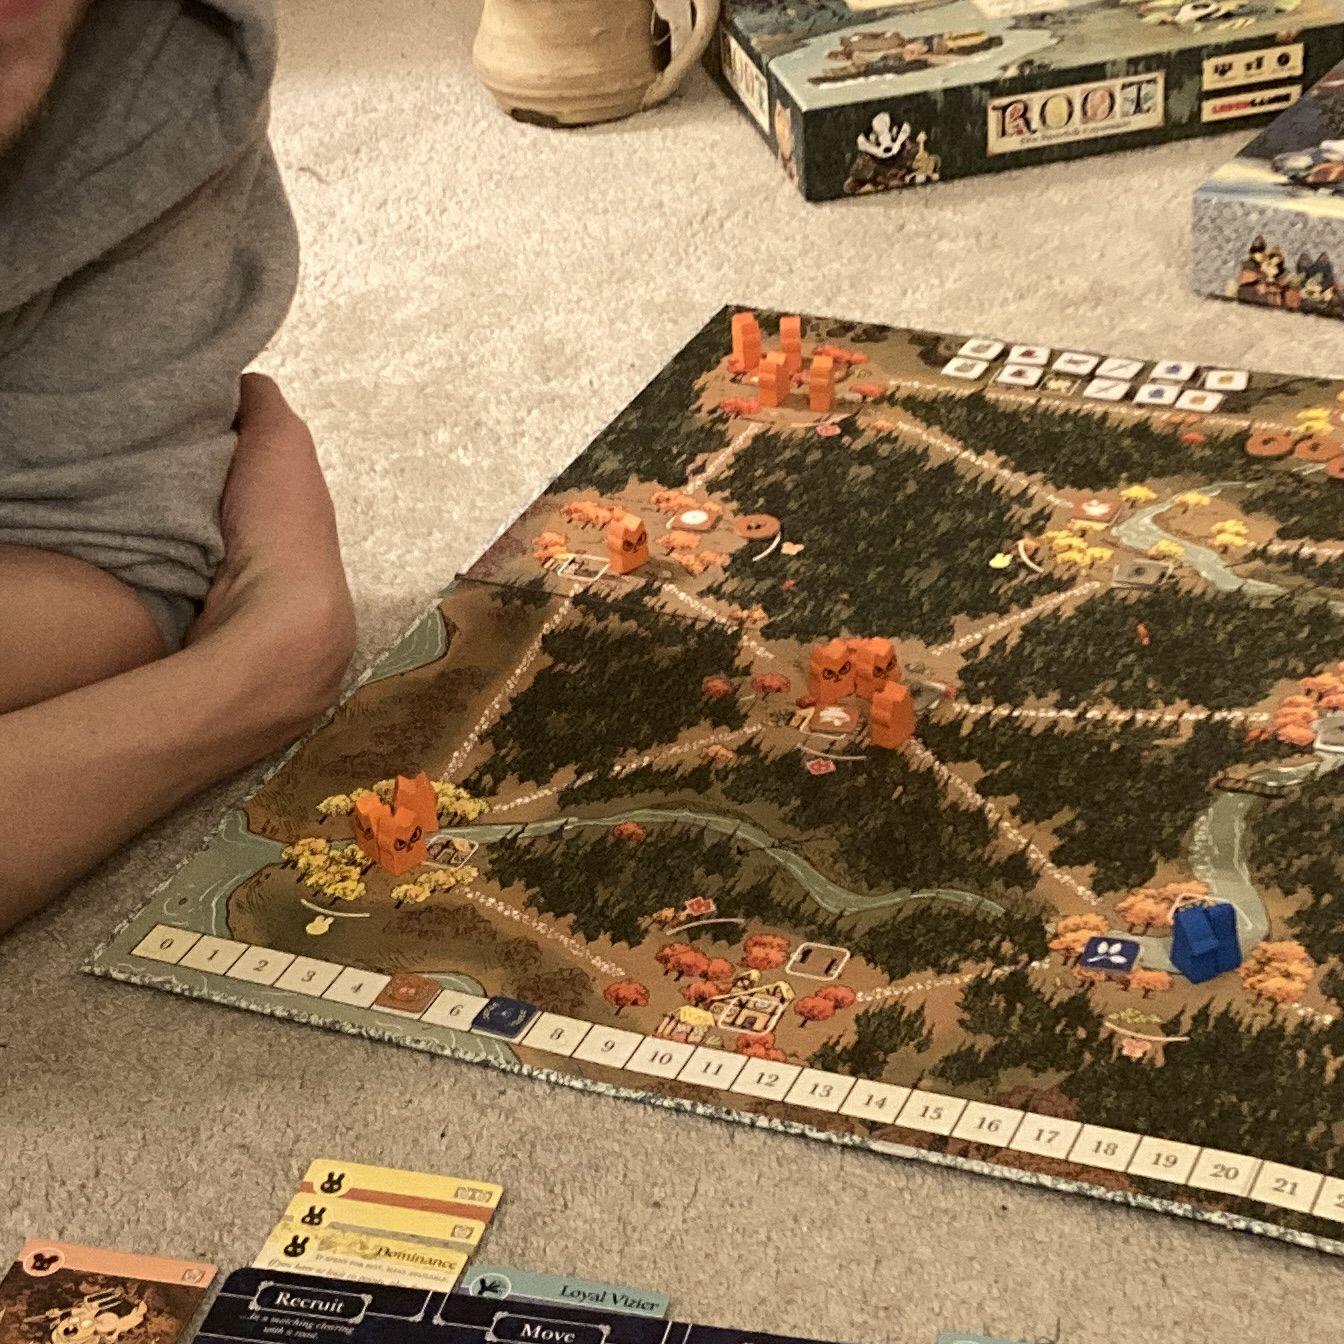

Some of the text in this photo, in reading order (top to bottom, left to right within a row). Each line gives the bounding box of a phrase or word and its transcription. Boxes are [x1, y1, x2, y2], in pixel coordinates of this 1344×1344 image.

[991, 78, 1158, 139] ROOT
[160, 938, 174, 950] 0
[207, 949, 220, 961] 1
[253, 960, 269, 972] 2
[301, 970, 316, 982] 3
[351, 983, 364, 994] 4
[449, 1004, 464, 1016] 6
[550, 1028, 564, 1040] 8
[601, 1040, 616, 1052] 9
[649, 1050, 673, 1065] 10
[702, 1062, 723, 1076] 11
[756, 1072, 780, 1087] 12
[809, 1083, 834, 1098] 13
[864, 1094, 887, 1109] 14
[919, 1105, 943, 1120] 15
[976, 1116, 1002, 1132] 16
[1034, 1128, 1060, 1144] 17
[1092, 1140, 1118, 1156] 18
[1151, 1152, 1178, 1168] 19
[1211, 1163, 1241, 1181] 20
[1272, 1178, 1300, 1196] 21
[374, 1246, 457, 1272] Dominance
[275, 1291, 343, 1312] Recruit
[561, 1284, 660, 1311] Loyal Vizier
[520, 1323, 575, 1342] Move
